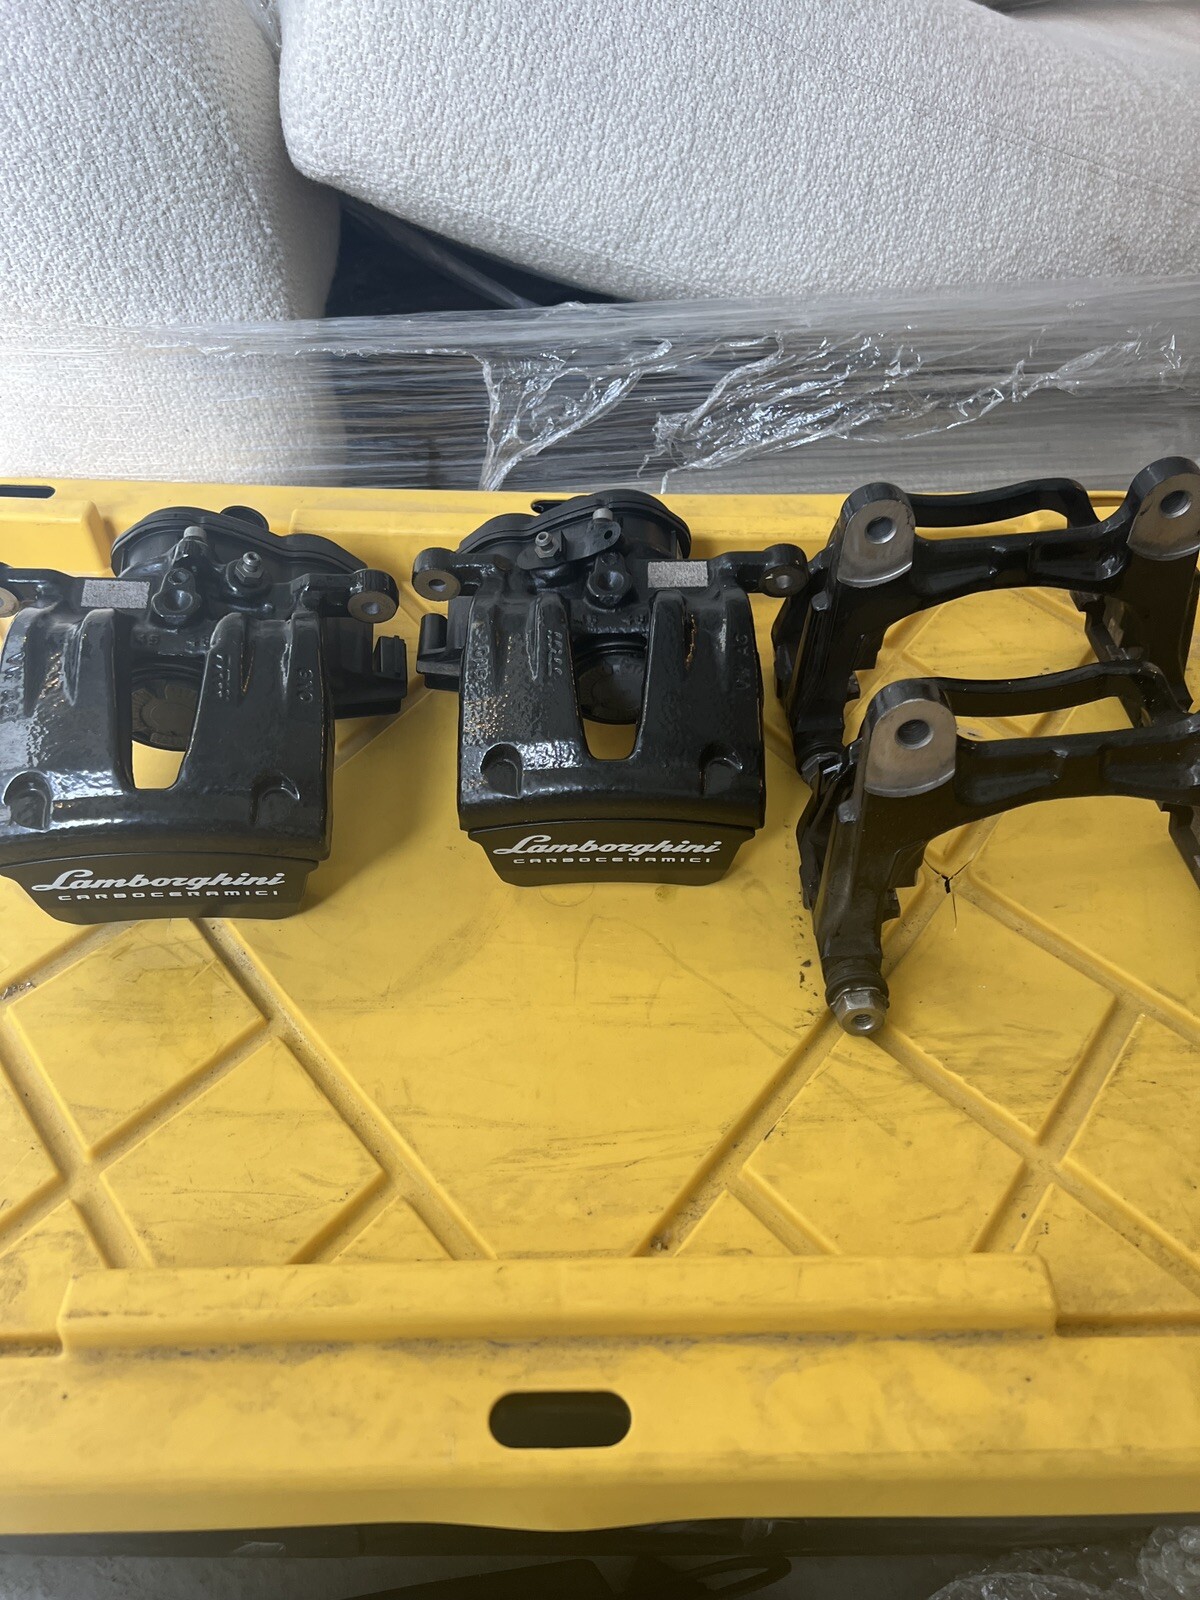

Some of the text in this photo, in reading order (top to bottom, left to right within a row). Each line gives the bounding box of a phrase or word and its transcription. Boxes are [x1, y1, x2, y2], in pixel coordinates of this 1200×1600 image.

[493, 834, 723, 856] Lamborghini
[31, 869, 286, 892] Lamborghini
[57, 890, 279, 901] CARBOCERAMICI
